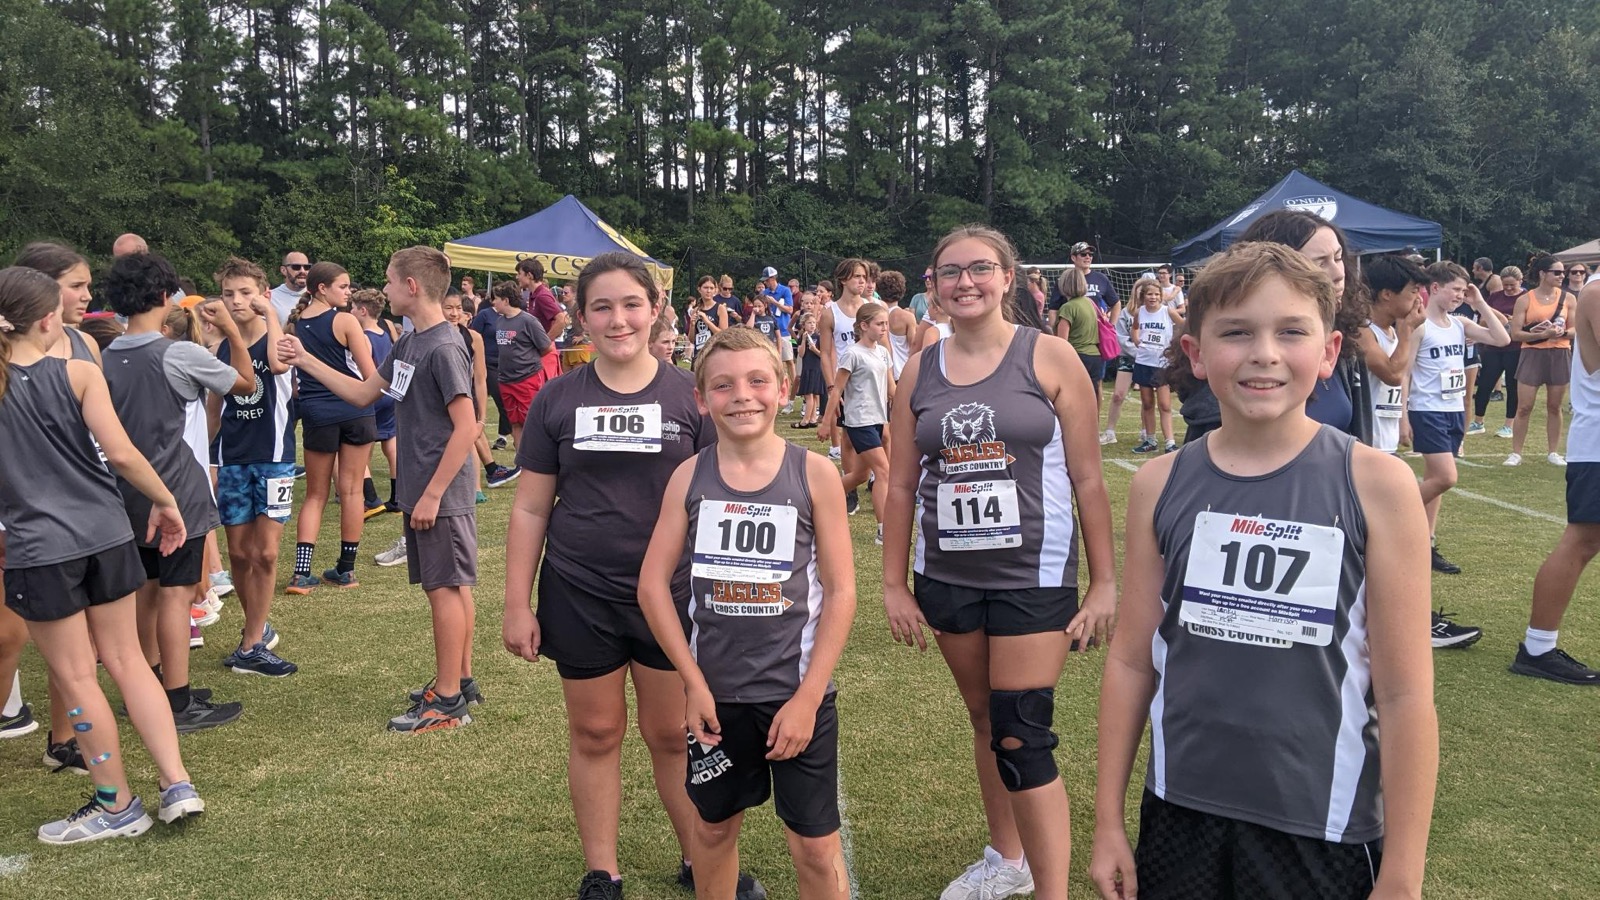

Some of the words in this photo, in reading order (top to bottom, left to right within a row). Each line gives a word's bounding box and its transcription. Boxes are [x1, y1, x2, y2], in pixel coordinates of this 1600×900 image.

[1286, 197, 1333, 205] O'NEAL
[395, 370, 408, 391] 111
[236, 408, 264, 419] PREP
[597, 406, 639, 414] MileSplit
[593, 415, 645, 434] 106
[940, 441, 1005, 465] EAGLES
[947, 463, 968, 472] CROSS
[969, 460, 1004, 471] COUNTRY
[954, 482, 993, 494] MileSplit
[723, 503, 772, 517] MileSplit
[951, 496, 1003, 525] 114
[718, 519, 776, 555] 100
[1230, 518, 1303, 541] MileSplit
[1220, 540, 1311, 596] 107
[713, 582, 781, 603] EAGLES
[715, 605, 739, 613] CROSS
[741, 605, 779, 614] COUNTRY
